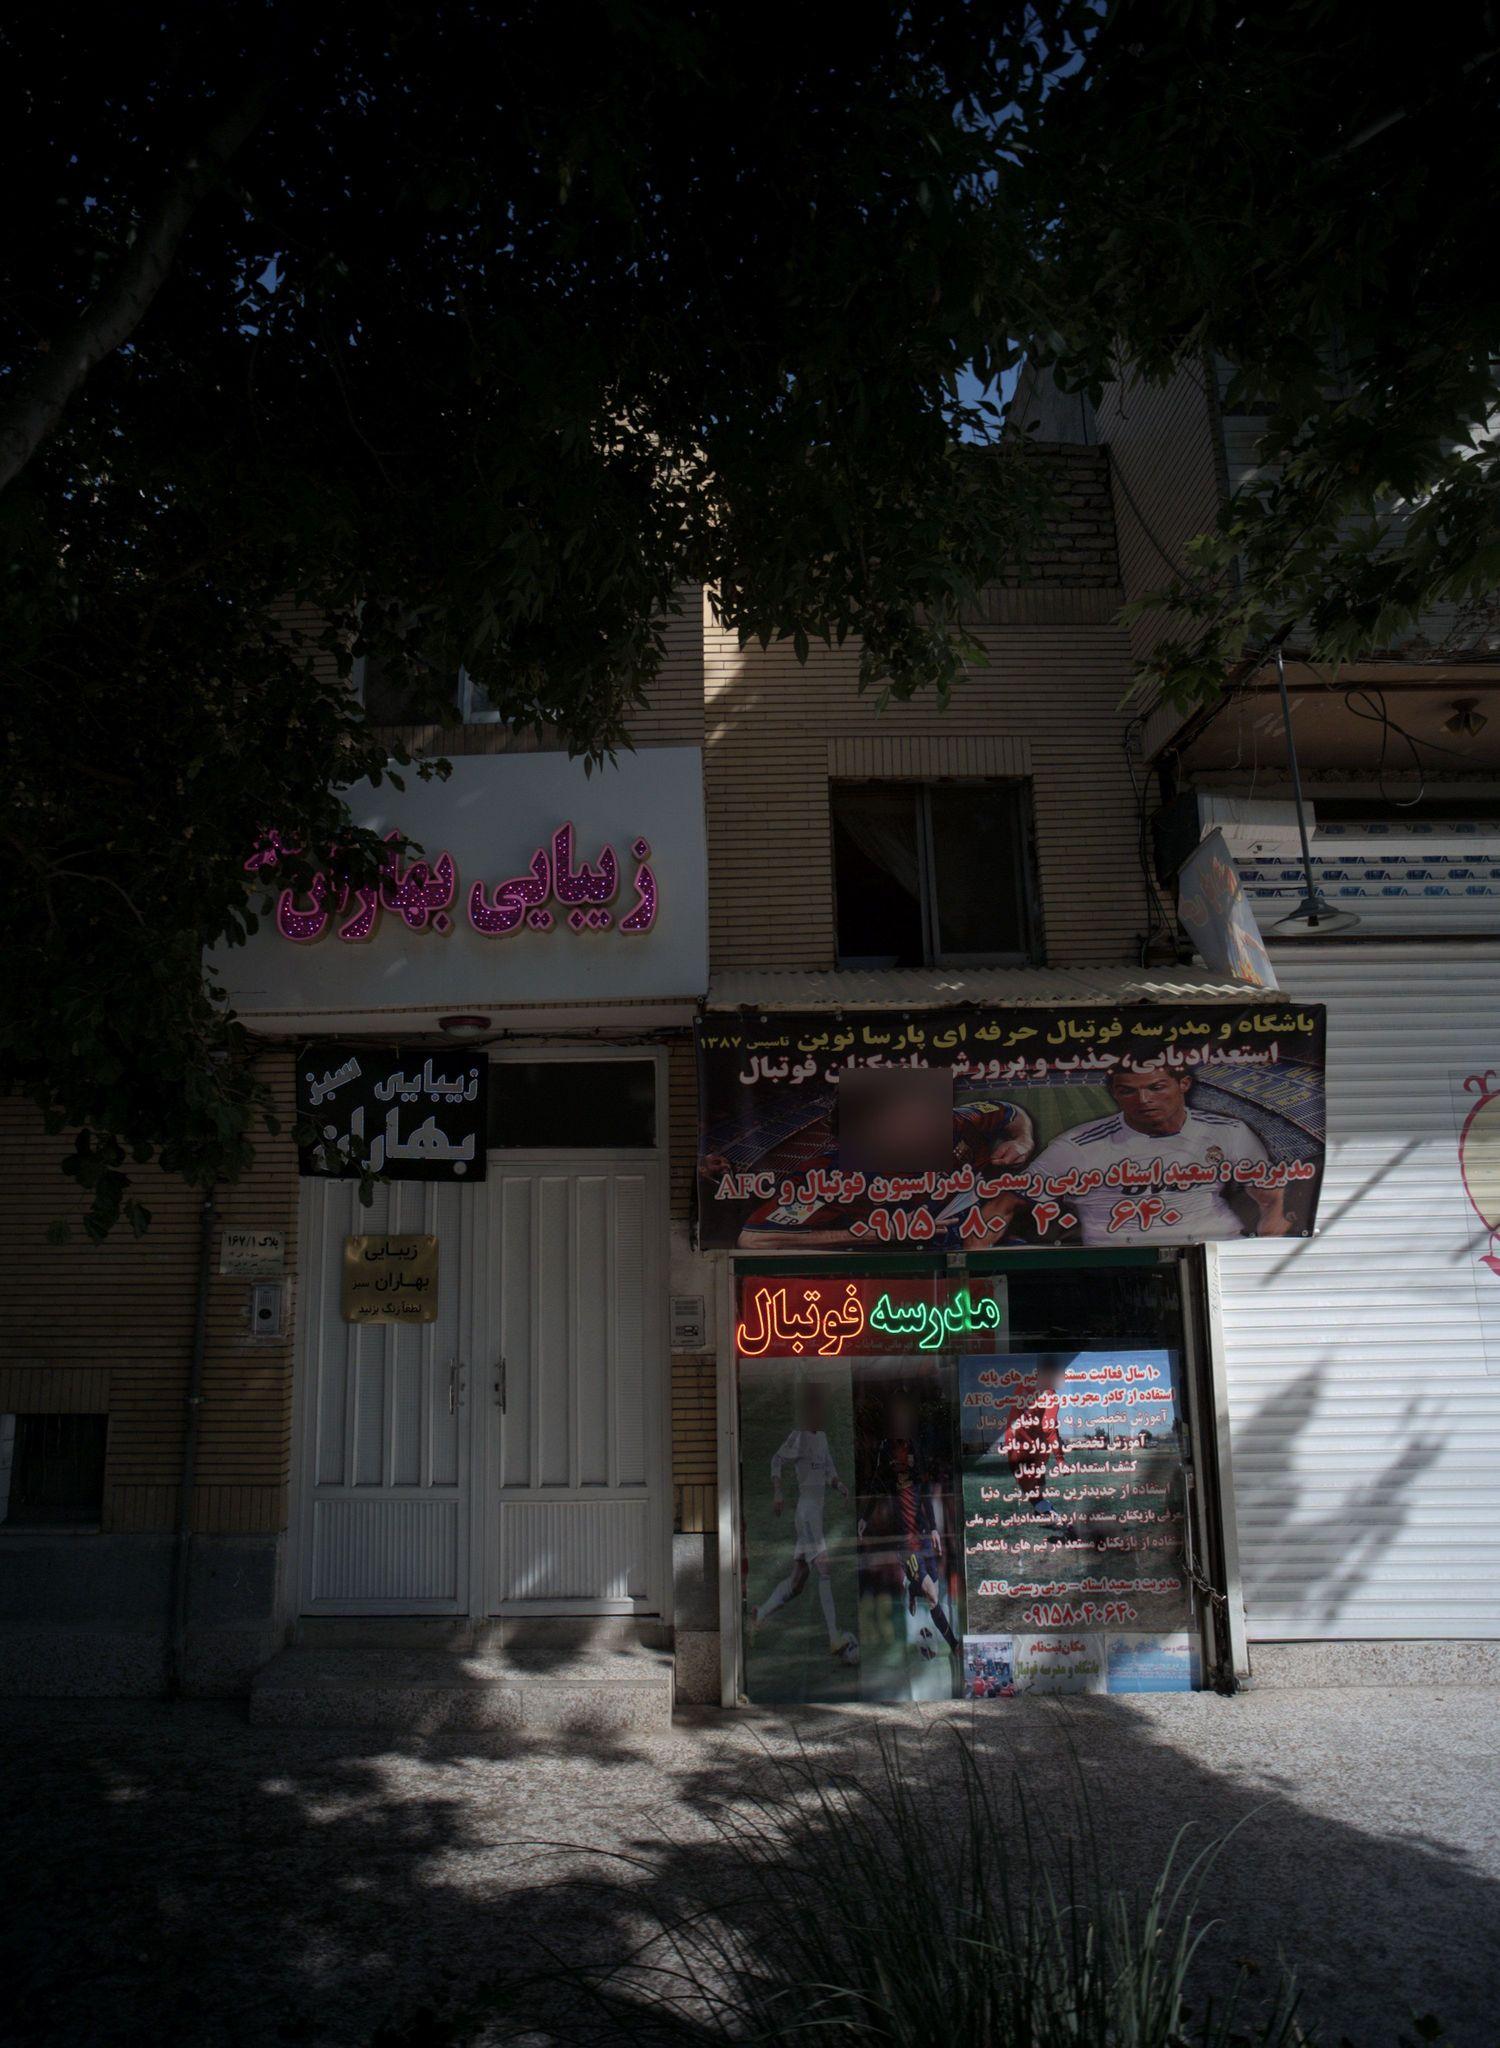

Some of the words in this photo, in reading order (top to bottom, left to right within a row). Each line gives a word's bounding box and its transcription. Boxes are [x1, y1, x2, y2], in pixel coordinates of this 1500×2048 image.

[469, 821, 660, 936] زیبایی
[975, 1020, 1038, 1047] حرفه
[1046, 1017, 1123, 1044] فوتبال
[1131, 1020, 1211, 1042] مدرسه
[1218, 1021, 1231, 1040] و
[1238, 1013, 1315, 1037] باشگاه
[700, 1036, 743, 1049] ۱۳۸۷
[746, 1036, 790, 1050] تاسیس
[796, 1027, 855, 1051] نوین
[862, 1025, 927, 1050] پارسا
[932, 1023, 967, 1048] ای
[739, 1055, 817, 1085] فوتبال
[951, 1051, 1027, 1079] پرورش
[1028, 1055, 1047, 1078] و
[305, 1056, 362, 1106] سبز
[374, 1058, 479, 1102] زیبایی
[312, 1105, 476, 1176] بهاران
[1107, 1158, 1161, 1186] استاد
[1164, 1160, 1216, 1191] سعید
[1234, 1160, 1315, 1189] مدیریت
[714, 1172, 775, 1201] AFC
[798, 1169, 867, 1203] فوتبال
[868, 1164, 976, 1203] فدراسیون
[977, 1170, 1043, 1198] رسمی
[1048, 1167, 1100, 1195] مربی
[779, 1180, 795, 1204] و
[849, 1207, 936, 1241] ۰۹۱۵
[958, 1205, 1008, 1239] ۸۰
[1031, 1201, 1078, 1235] ۴۰
[1107, 1197, 1182, 1233] ۶۴۰
[258, 1236, 279, 1250] پلاک
[365, 1241, 418, 1261] زیبایی
[352, 1280, 370, 1290] سبز
[375, 1272, 429, 1291] بهاران
[737, 1284, 864, 1355] فوتبال
[870, 1289, 1000, 1349] مدرسه
[979, 1371, 998, 1387] پایه
[1000, 1370, 1021, 1386] های
[1090, 1366, 1123, 1383] فعالیت
[1125, 1366, 1145, 1382] سال
[966, 1393, 992, 1407] AFC
[994, 1396, 1024, 1409] رسمی
[1061, 1394, 1068, 1407] و
[1070, 1392, 1100, 1406] مجرب
[1101, 1389, 1125, 1406] کادر
[1127, 1388, 1137, 1405] از
[1139, 1388, 1175, 1402] استفاده
[1011, 1412, 1040, 1430] دنیای
[1041, 1415, 1061, 1430] روز
[1077, 1417, 1082, 1427] و
[1085, 1412, 1127, 1427] تخصصی
[1130, 1409, 1167, 1426] آموزش
[1061, 1436, 1105, 1451] تخصصی
[1107, 1433, 1146, 1452] آموزش
[1014, 1462, 1047, 1479] فوتبال
[1049, 1461, 1110, 1478] استعدادهای
[1111, 1460, 1138, 1473] کشف
[981, 1487, 1000, 1501] دنیا
[1063, 1484, 1117, 1501] جدیدترین
[1120, 1483, 1130, 1499] از
[1132, 1482, 1171, 1495] استفاده
[965, 1514, 983, 1527] ملی
[986, 1514, 999, 1527] تیم
[1089, 1511, 1117, 1521] مستعد
[1118, 1509, 1155, 1523] بازیکنان
[1157, 1508, 1184, 1523] عرفی
[966, 1539, 1008, 1555] باشگاهی
[1010, 1539, 1031, 1553] های
[1033, 1538, 1048, 1551] تیم
[1051, 1540, 1062, 1552] در
[1097, 1536, 1138, 1552] بازیکنان
[1141, 1537, 1150, 1550] از
[1152, 1536, 1184, 1547] ستفاده
[979, 1581, 1007, 1594] AFC
[1009, 1582, 1039, 1597] رسمی
[1042, 1582, 1067, 1596] مربی
[1082, 1578, 1106, 1591] استاد
[1109, 1578, 1133, 1594] سعید
[1141, 1578, 1180, 1592] مدیریت
[1023, 1603, 1137, 1625] ۰۹۱۵۸۰۴۰۶۴۰
